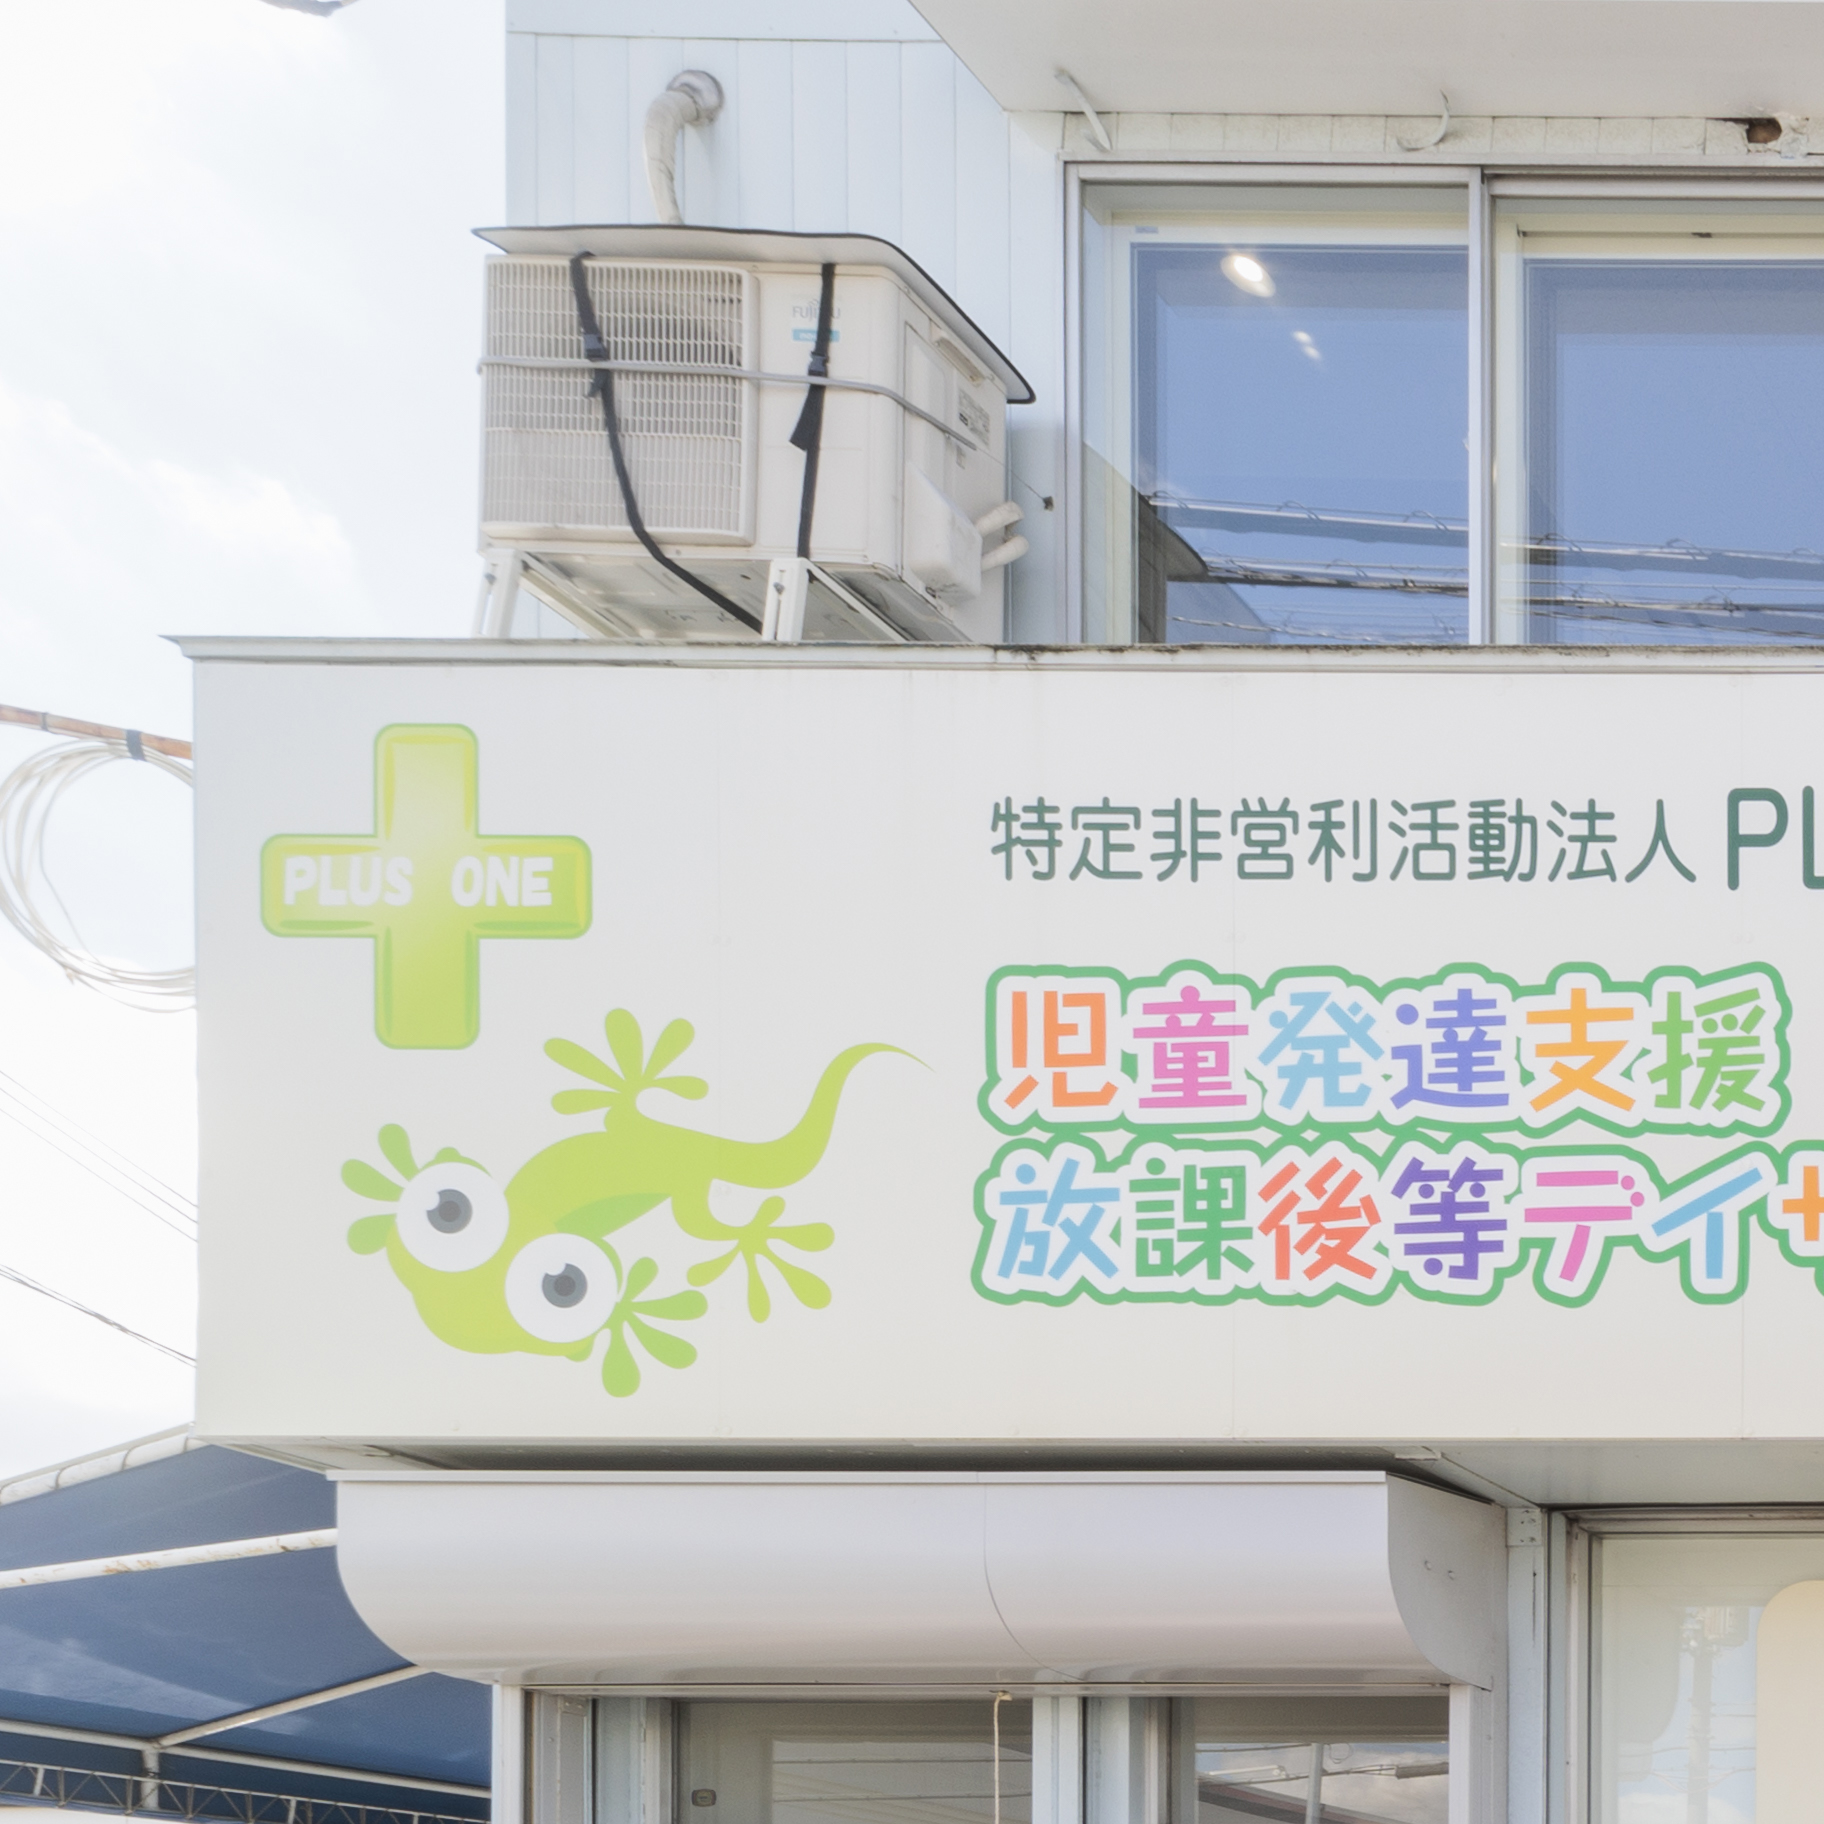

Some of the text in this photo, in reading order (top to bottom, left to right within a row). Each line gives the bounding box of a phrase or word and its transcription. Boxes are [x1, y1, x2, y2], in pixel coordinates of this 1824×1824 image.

[792, 306, 840, 321] FUJIU
[989, 798, 1697, 883] 特定非営利活動法人
[282, 854, 553, 908] PLUS ONE
[994, 975, 1781, 1124] 児童発達支援
